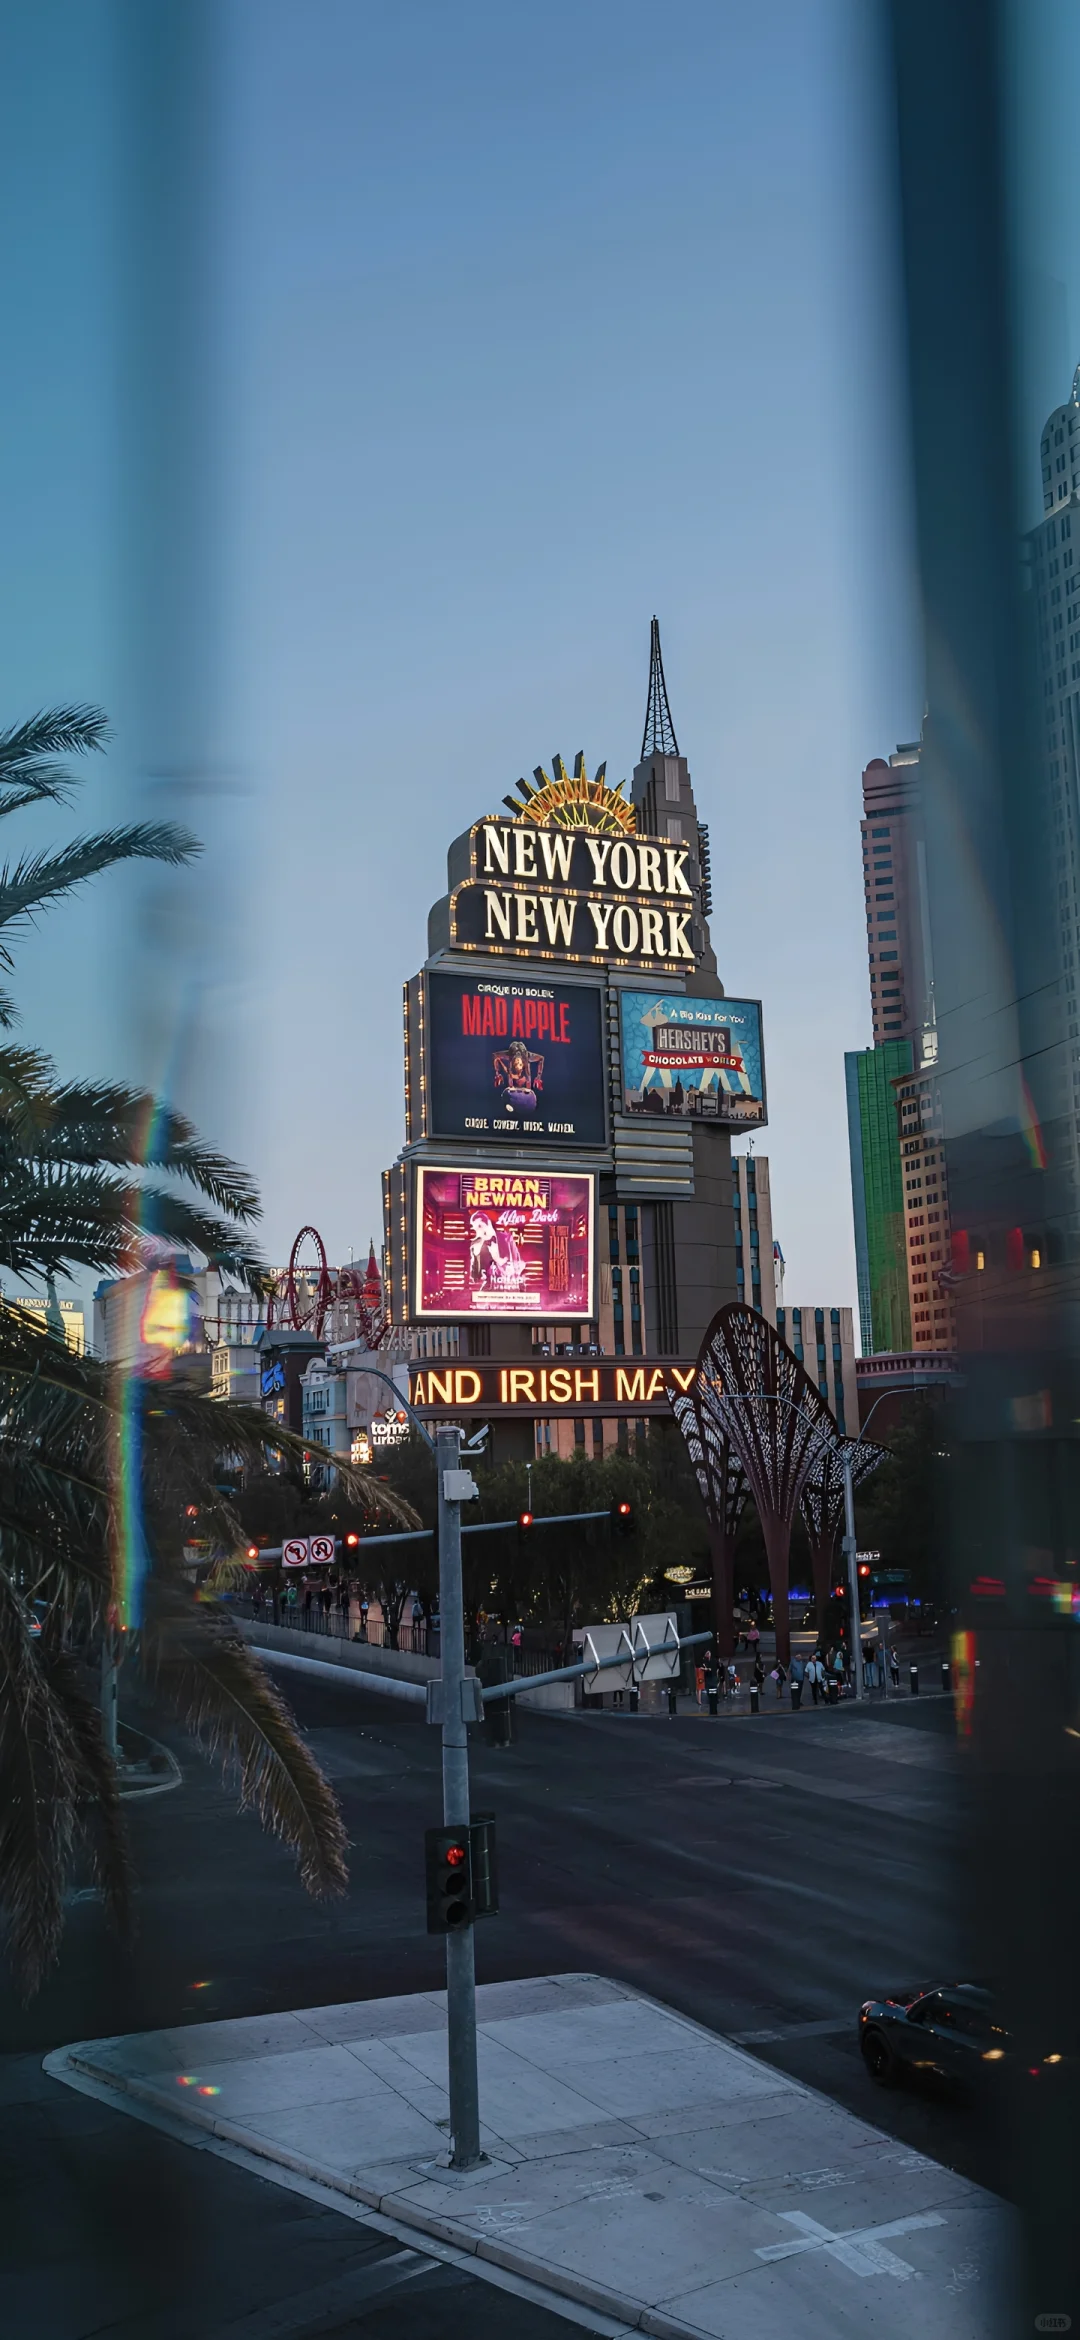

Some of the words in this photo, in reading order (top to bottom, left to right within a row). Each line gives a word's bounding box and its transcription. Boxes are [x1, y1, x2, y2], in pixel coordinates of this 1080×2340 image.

[482, 824, 576, 882] NEW
[584, 837, 693, 897] YORK
[483, 890, 578, 947] NEW
[587, 901, 696, 959] YORK
[511, 986, 524, 996] DU
[462, 994, 507, 1036] MAD
[511, 998, 571, 1043] APPLE
[670, 1009, 678, 1018] A
[714, 1013, 728, 1022] For
[729, 1014, 745, 1024] You
[658, 1028, 726, 1053] HERSHEY'S
[648, 1054, 704, 1065] CHOCOLATE
[705, 1056, 737, 1066] WORLD
[474, 1177, 540, 1193] BRIAN
[465, 1191, 547, 1209] NEWMAN
[413, 1370, 482, 1406] AND
[500, 1368, 600, 1404] IRISH
[616, 1367, 697, 1401] MAY
[371, 1421, 410, 1435] toms
